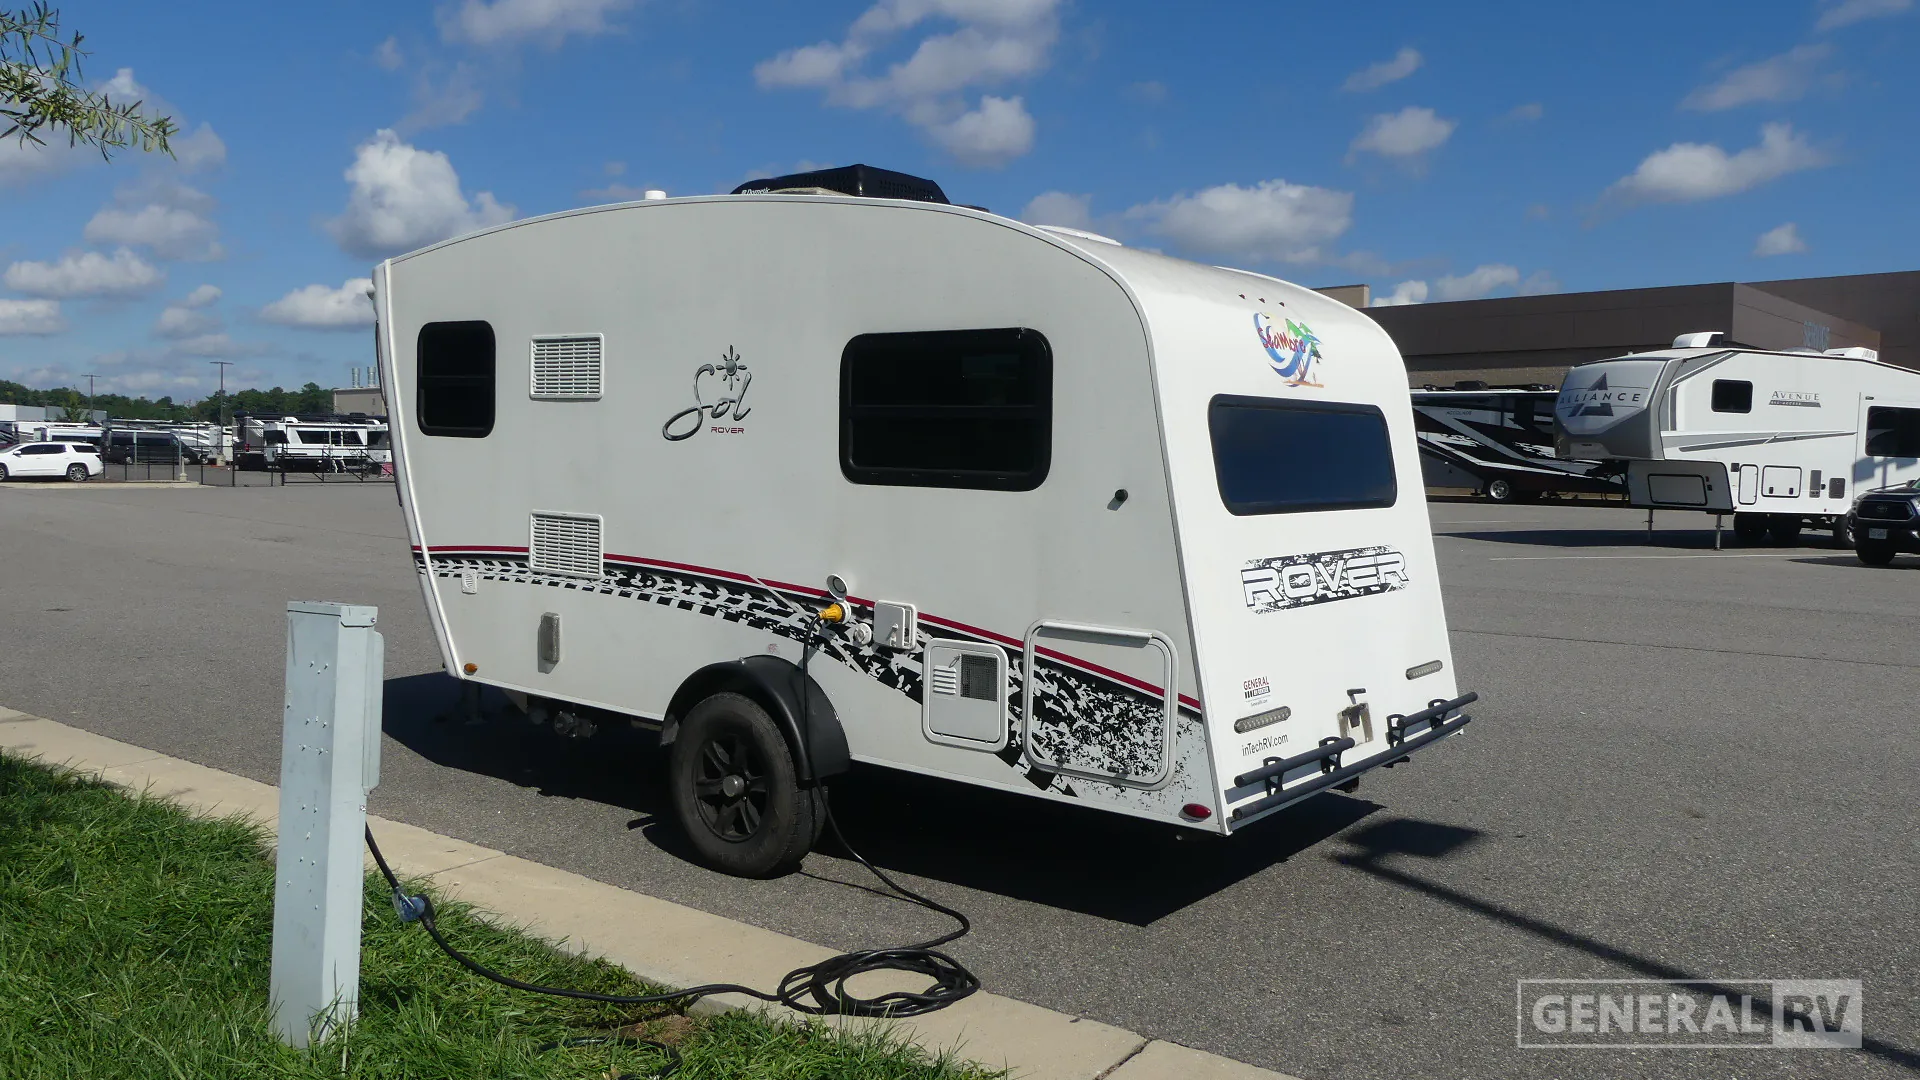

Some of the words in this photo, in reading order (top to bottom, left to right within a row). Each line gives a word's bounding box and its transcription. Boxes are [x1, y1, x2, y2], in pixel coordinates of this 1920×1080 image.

[1560, 392, 1641, 404] ALLIANCE
[710, 426, 745, 434] ROVER
[1240, 551, 1409, 608] ROVER
[1243, 676, 1269, 690] GENERAL
[1242, 734, 1288, 756] inTechRV.com
